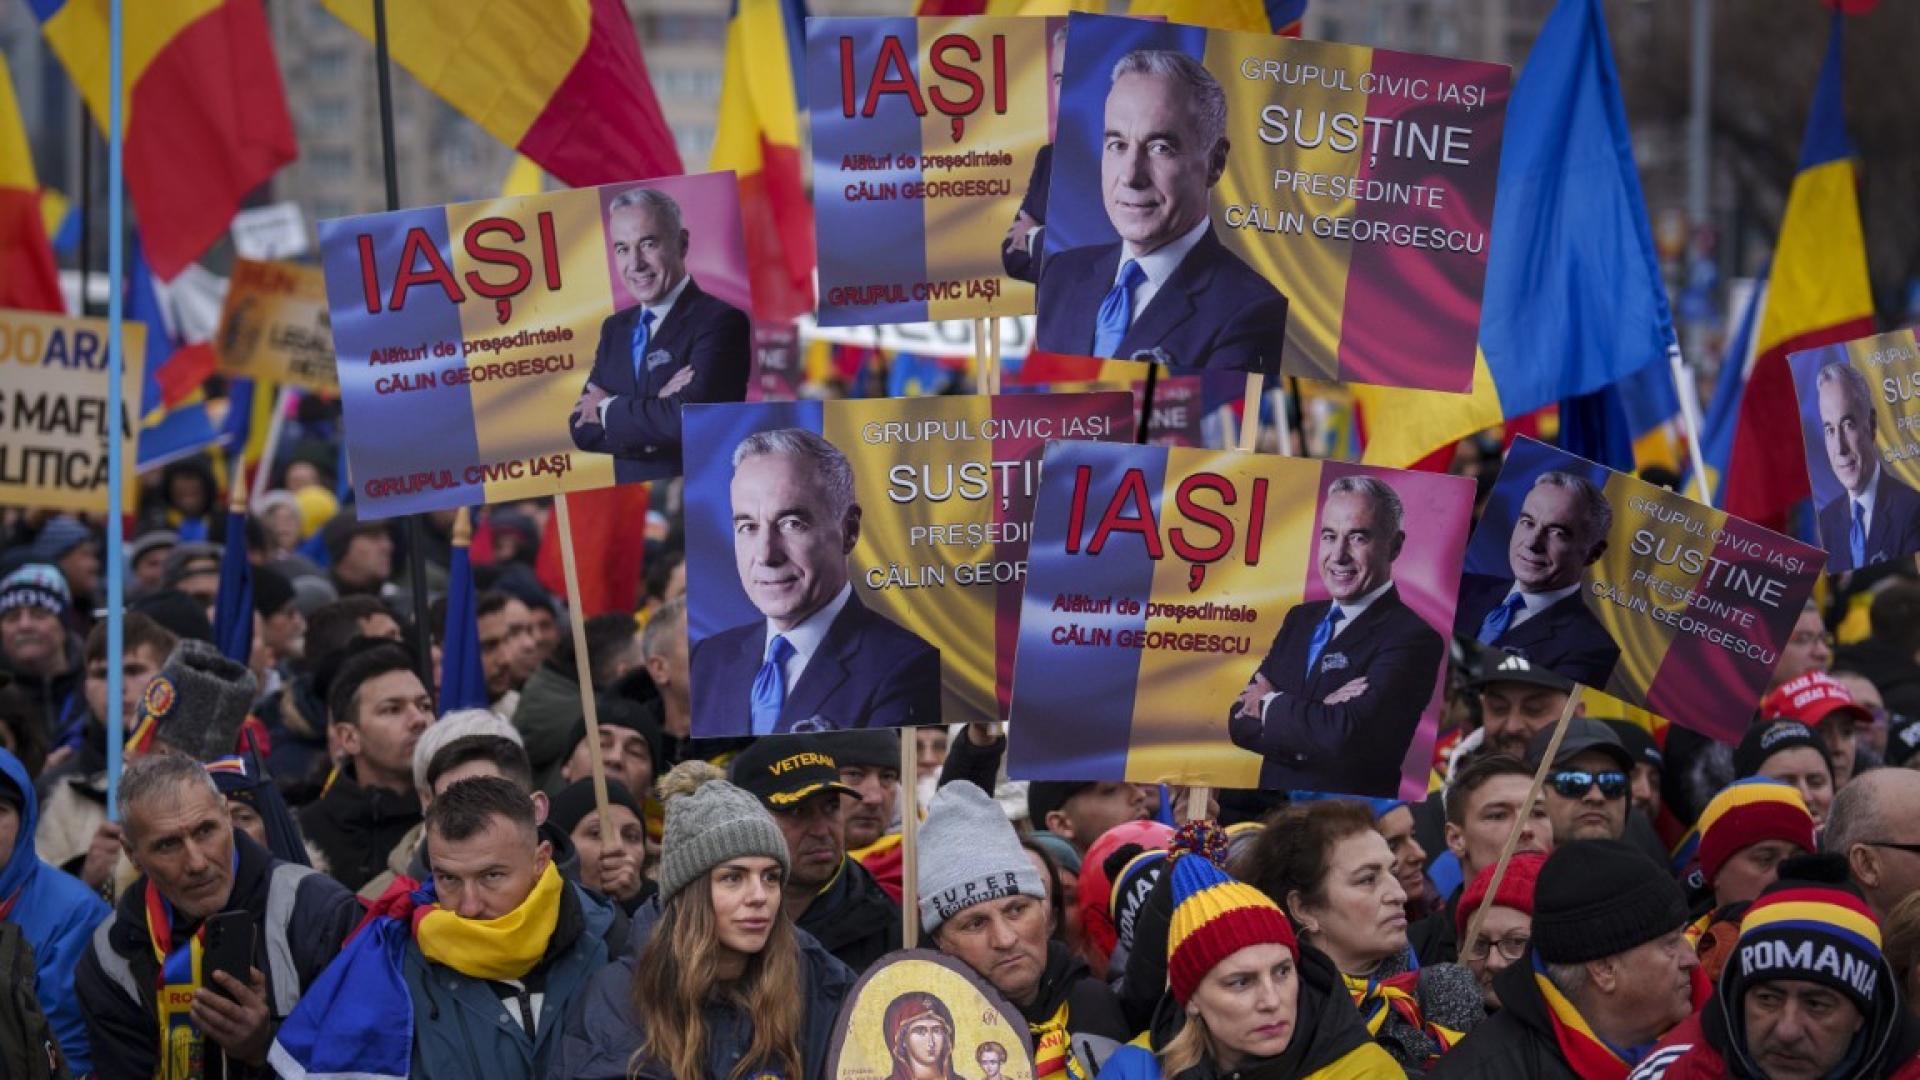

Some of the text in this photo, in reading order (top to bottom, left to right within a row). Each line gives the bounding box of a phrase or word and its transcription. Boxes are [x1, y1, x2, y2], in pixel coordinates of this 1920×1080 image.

[840, 33, 1008, 144] IAȘI
[1241, 57, 1486, 112] GRUPUL CIVIC IAȘI
[1258, 104, 1473, 168] SUSȚINE
[841, 151, 1012, 172] Alături de președintele
[844, 178, 1011, 201] CĂLIN GEORGESCU
[1274, 169, 1446, 209] PREȘEDINTE
[1225, 203, 1484, 254] CĂLIN GEORGESCU
[357, 211, 562, 324] IAȘI
[828, 279, 1000, 306] GRUPUL CIVIC IAȘI
[369, 326, 573, 366] Alături de președintele
[375, 366, 437, 395] CĂLIN
[441, 354, 575, 387] GEORGESCU
[863, 420, 976, 443] GRUPUL
[981, 417, 1053, 441] CIVIC
[365, 453, 572, 499] GRUPUL CIVIC IAȘI
[887, 460, 1044, 511] SUSȚI
[910, 522, 1035, 548] PREȘEDI
[1065, 464, 1269, 593] IAȘI
[1628, 496, 1805, 578] GRUPUL CIVIC IAȘI
[866, 562, 945, 590] CĂLIN
[1630, 530, 1787, 609] SUSȚINE
[1052, 594, 1258, 625] Alături de președintele
[1051, 622, 1250, 656] CĂLIN GEORGESCU
[1652, 606, 1776, 666] GEORGESCU
[769, 752, 836, 777] VETERAN
[932, 872, 1018, 910] SUPER
[1741, 938, 1878, 1001] ROMANIA
